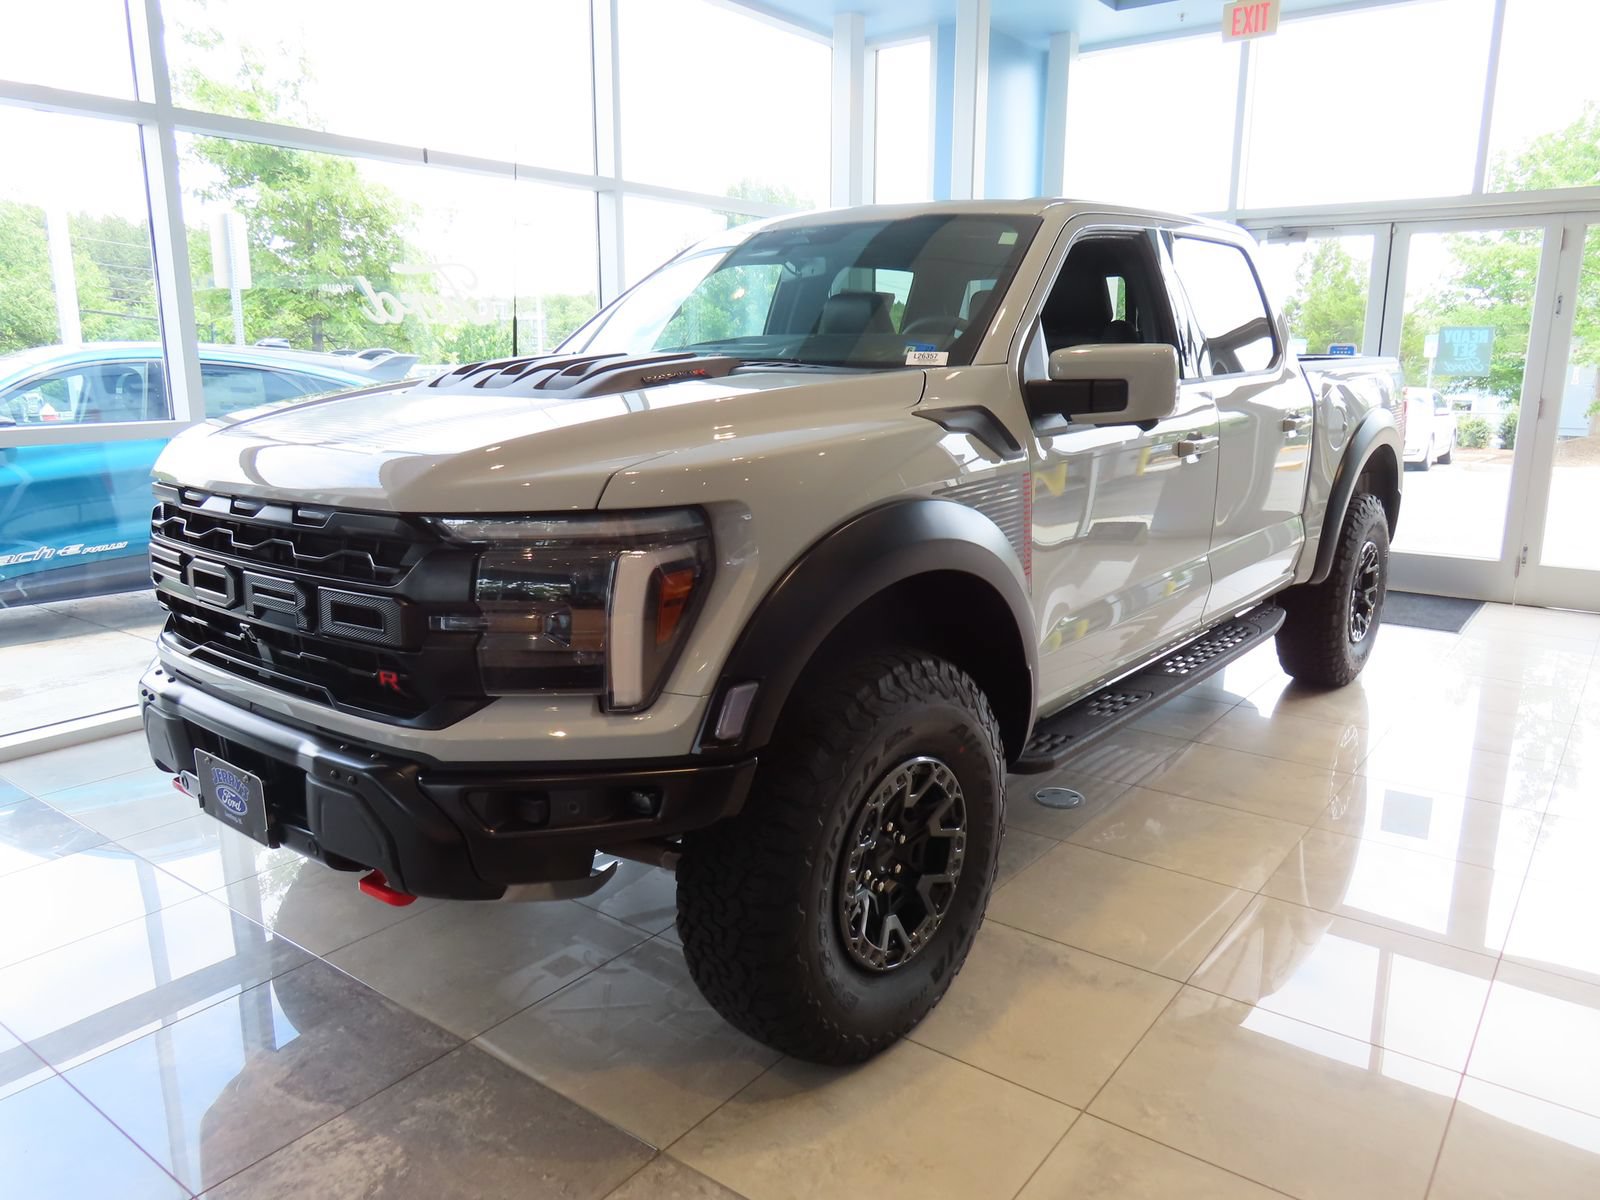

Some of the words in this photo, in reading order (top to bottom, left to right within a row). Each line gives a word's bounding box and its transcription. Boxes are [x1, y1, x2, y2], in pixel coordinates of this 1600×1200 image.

[1232, 2, 1270, 36] EXIT
[0, 543, 85, 567] ach-E
[149, 543, 402, 648] FORD
[378, 671, 401, 693] R
[221, 789, 241, 811] Ford
